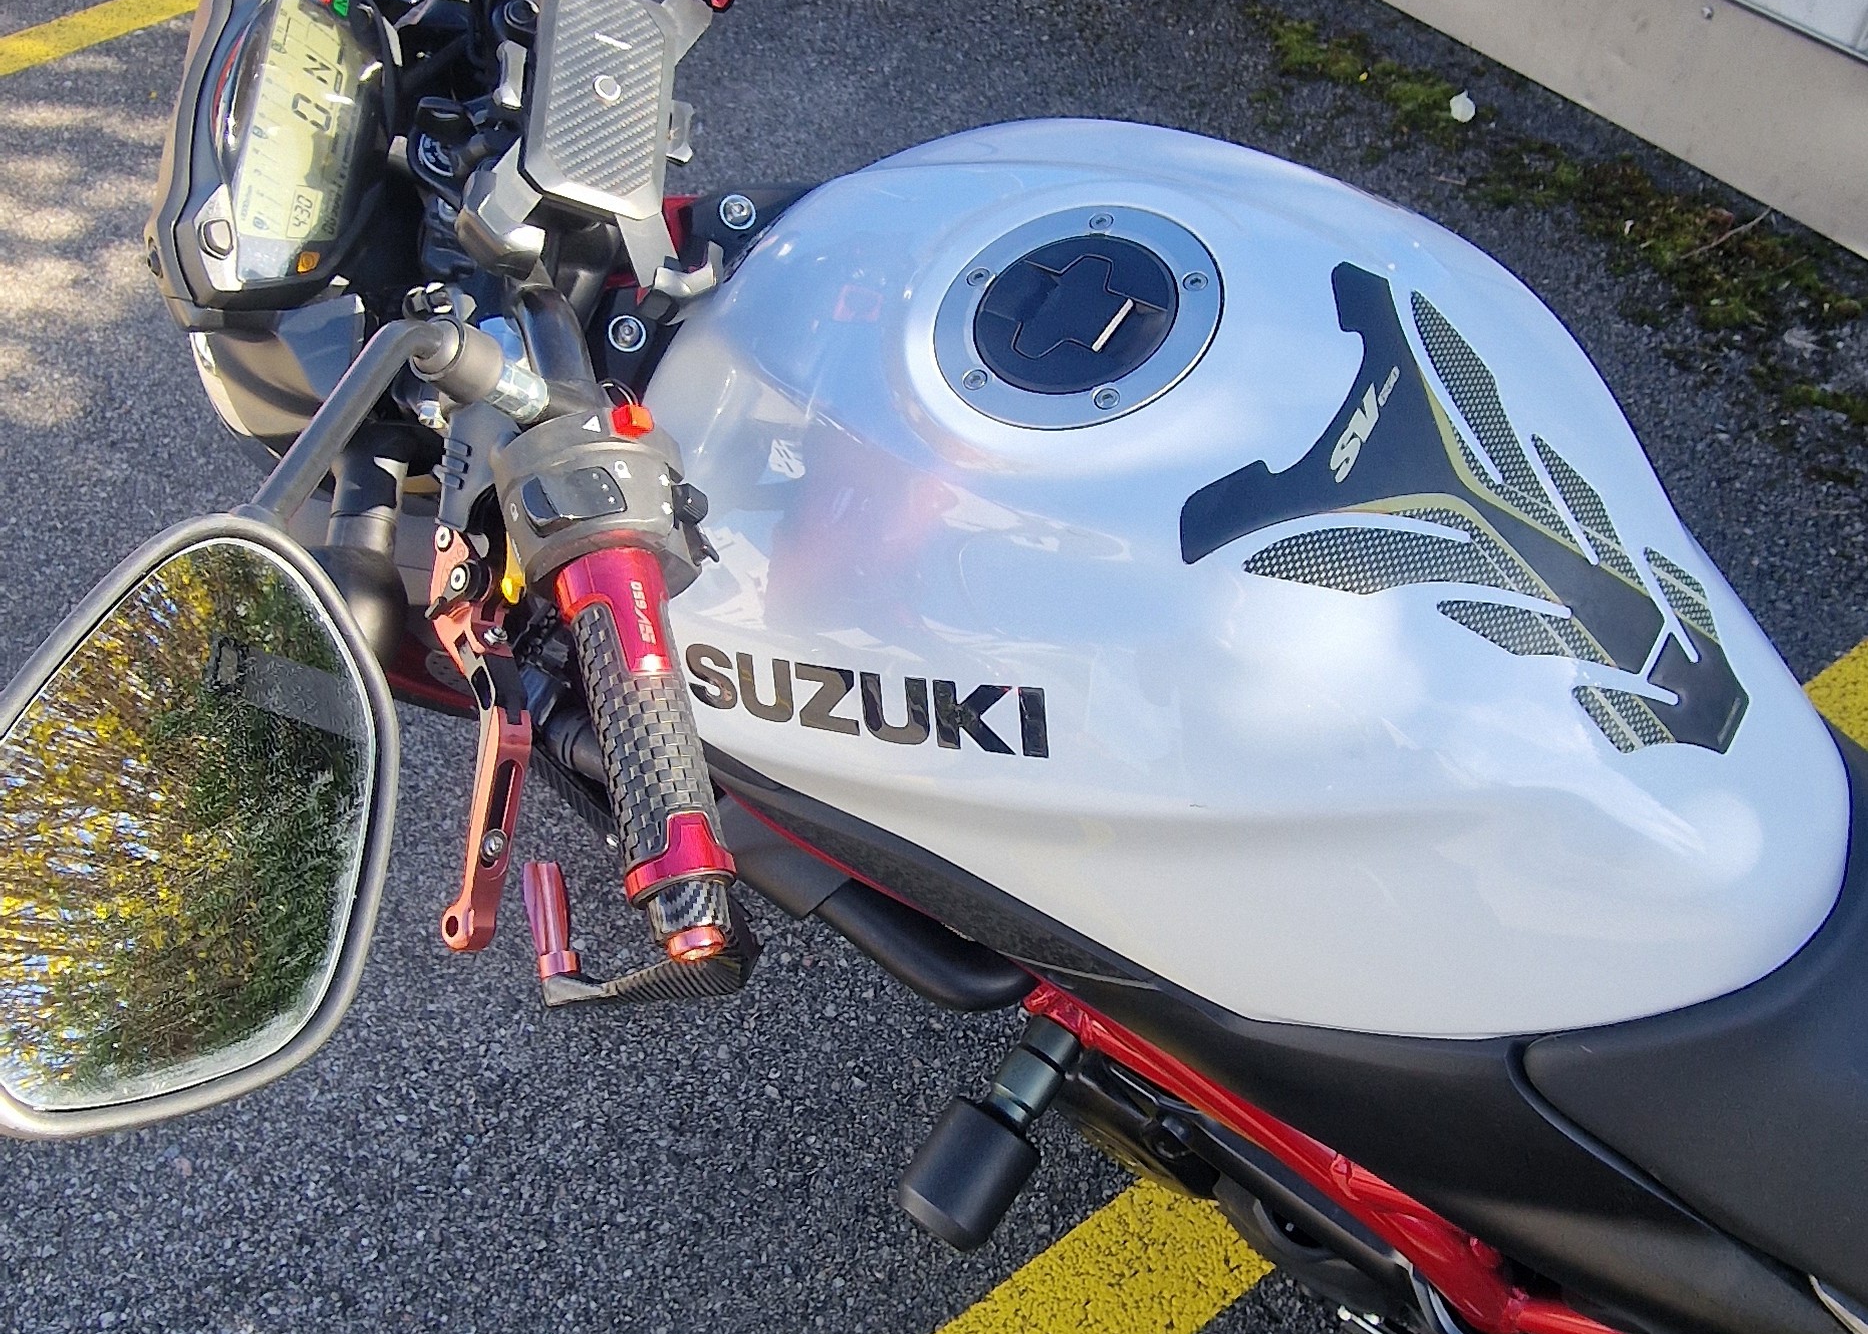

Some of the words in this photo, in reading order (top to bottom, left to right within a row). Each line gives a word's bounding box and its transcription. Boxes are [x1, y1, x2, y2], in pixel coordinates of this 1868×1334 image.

[303, 53, 331, 84] N
[292, 92, 332, 132] 0
[292, 194, 313, 228] 4:30
[630, 580, 657, 645] SV650
[685, 643, 1049, 759] SUZUKI
